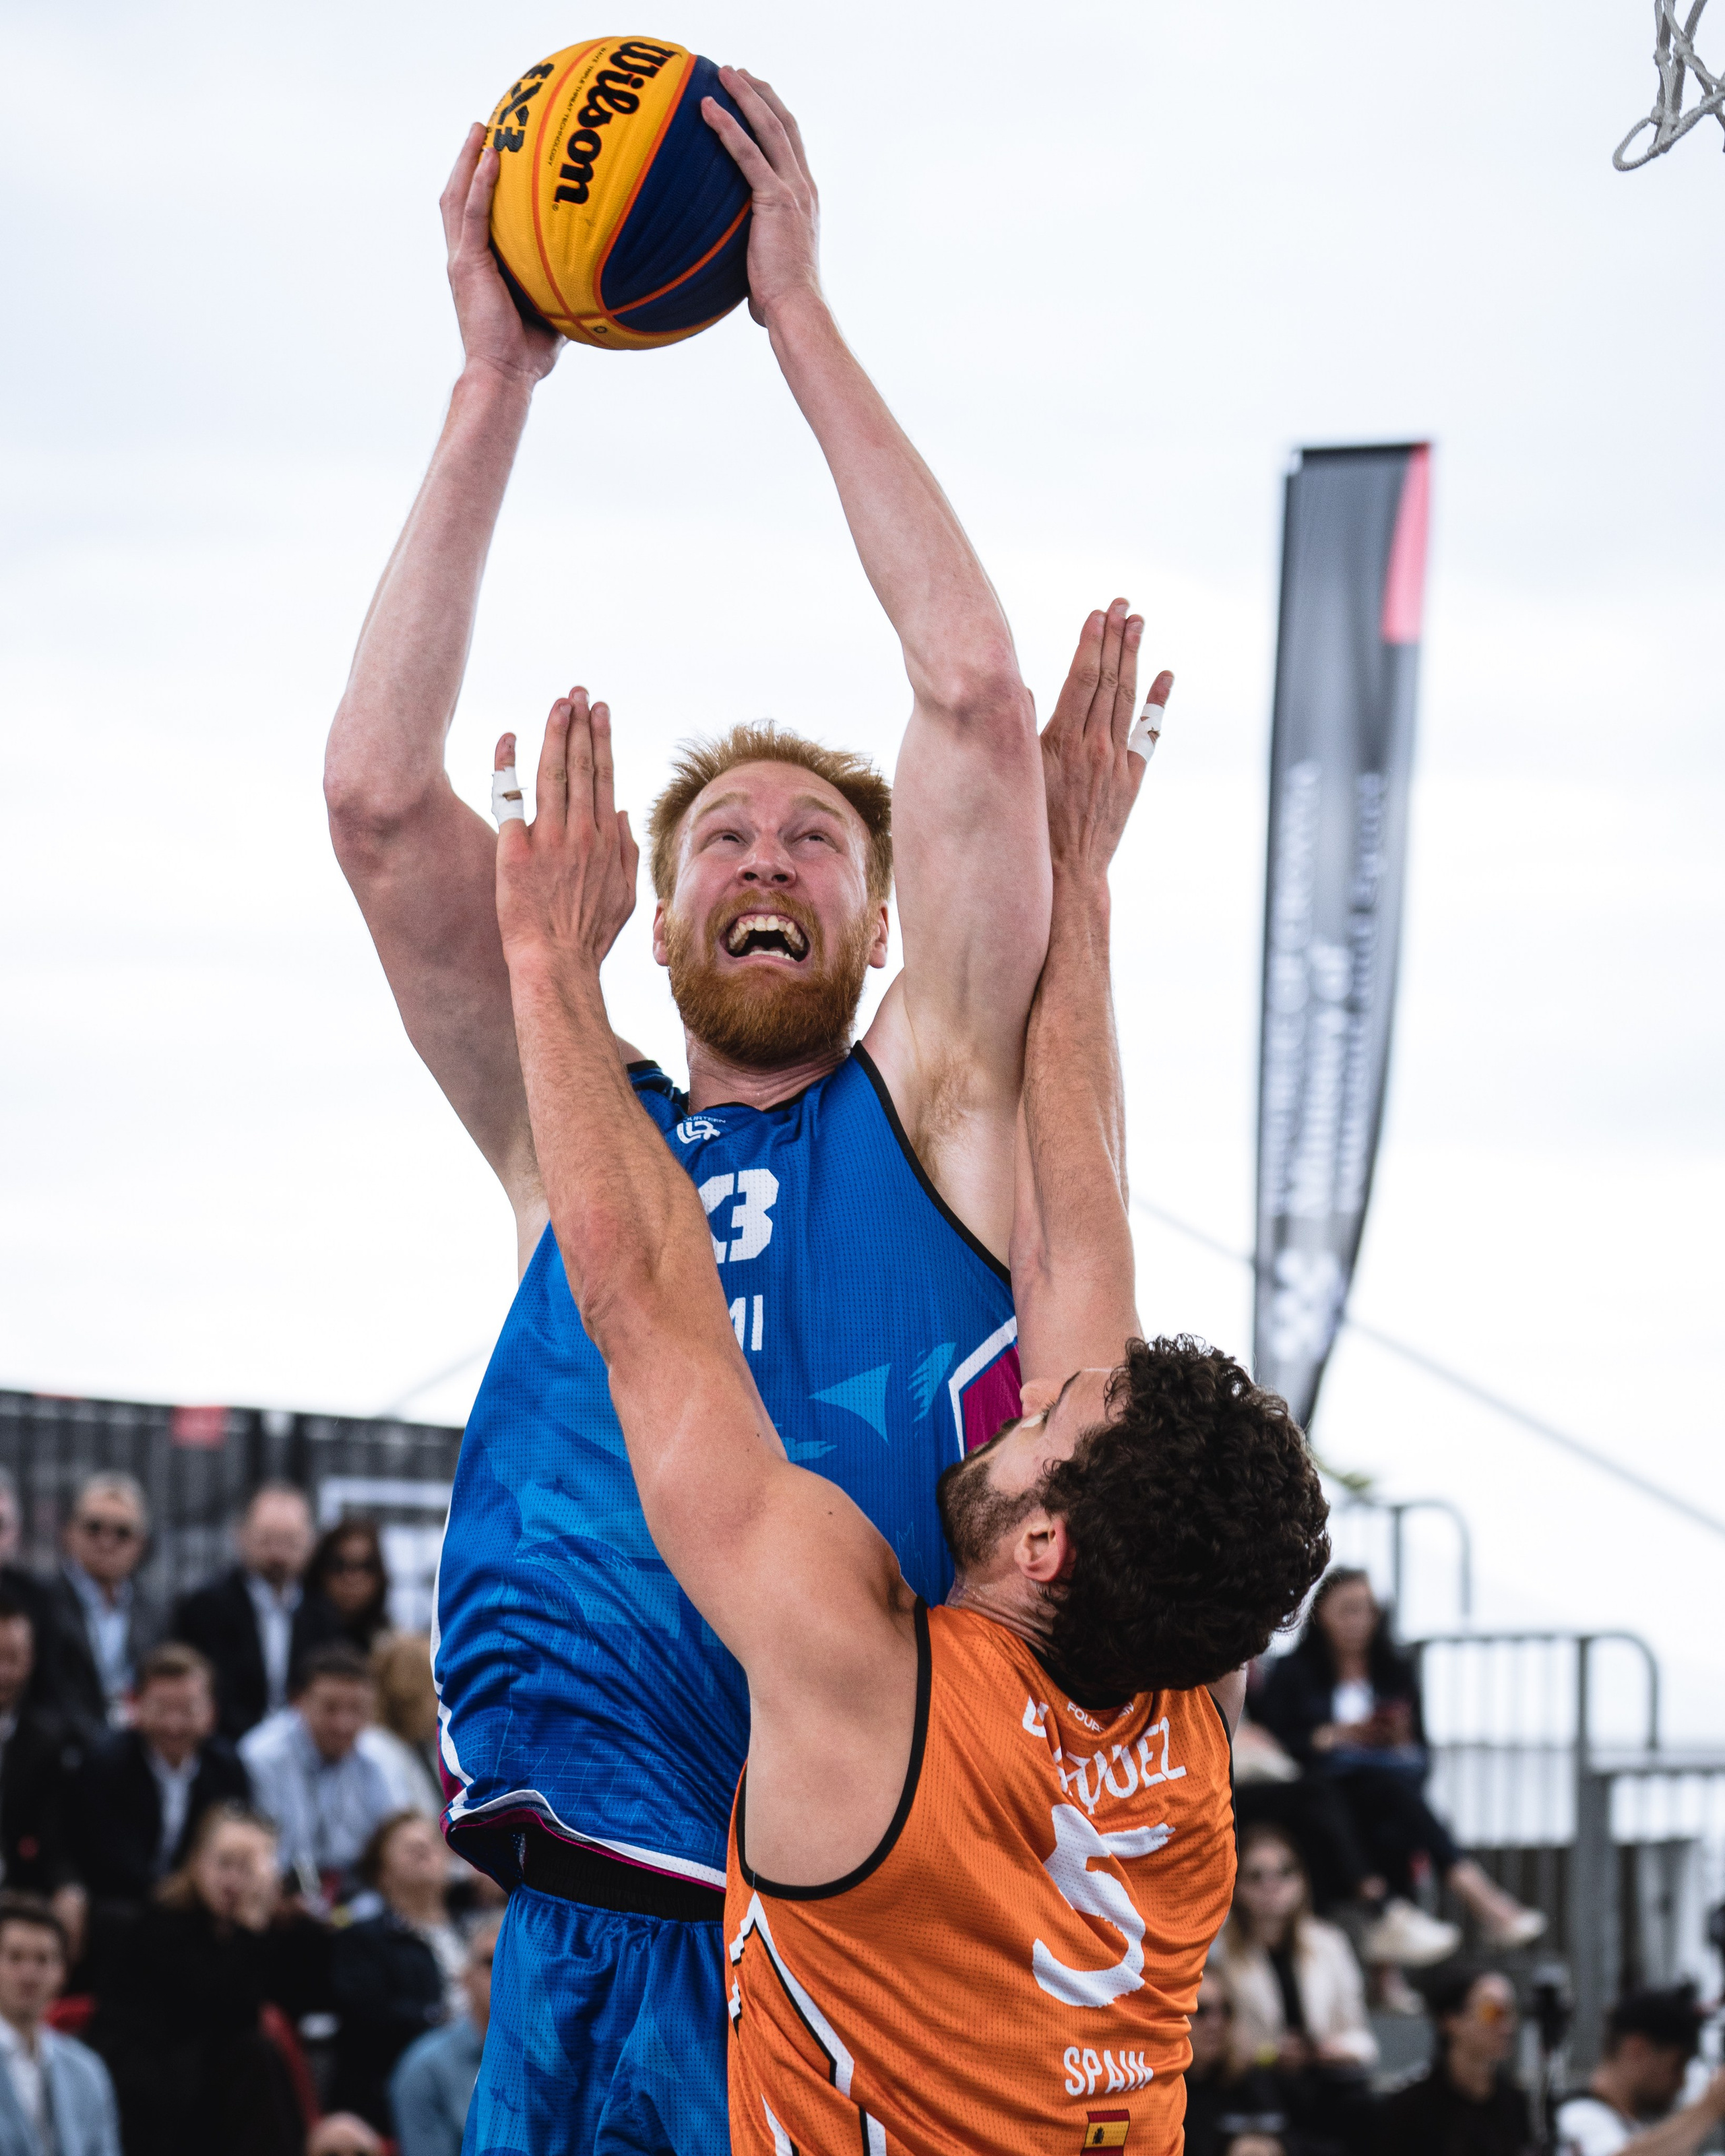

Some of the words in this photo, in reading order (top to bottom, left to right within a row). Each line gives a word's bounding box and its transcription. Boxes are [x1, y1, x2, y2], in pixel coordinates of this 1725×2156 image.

[548, 113, 569, 166] TECHNOLOGY
[555, 42, 682, 205] Wilson
[1032, 1804, 1176, 2008] 5
[1063, 2046, 1154, 2097] SPAIN
